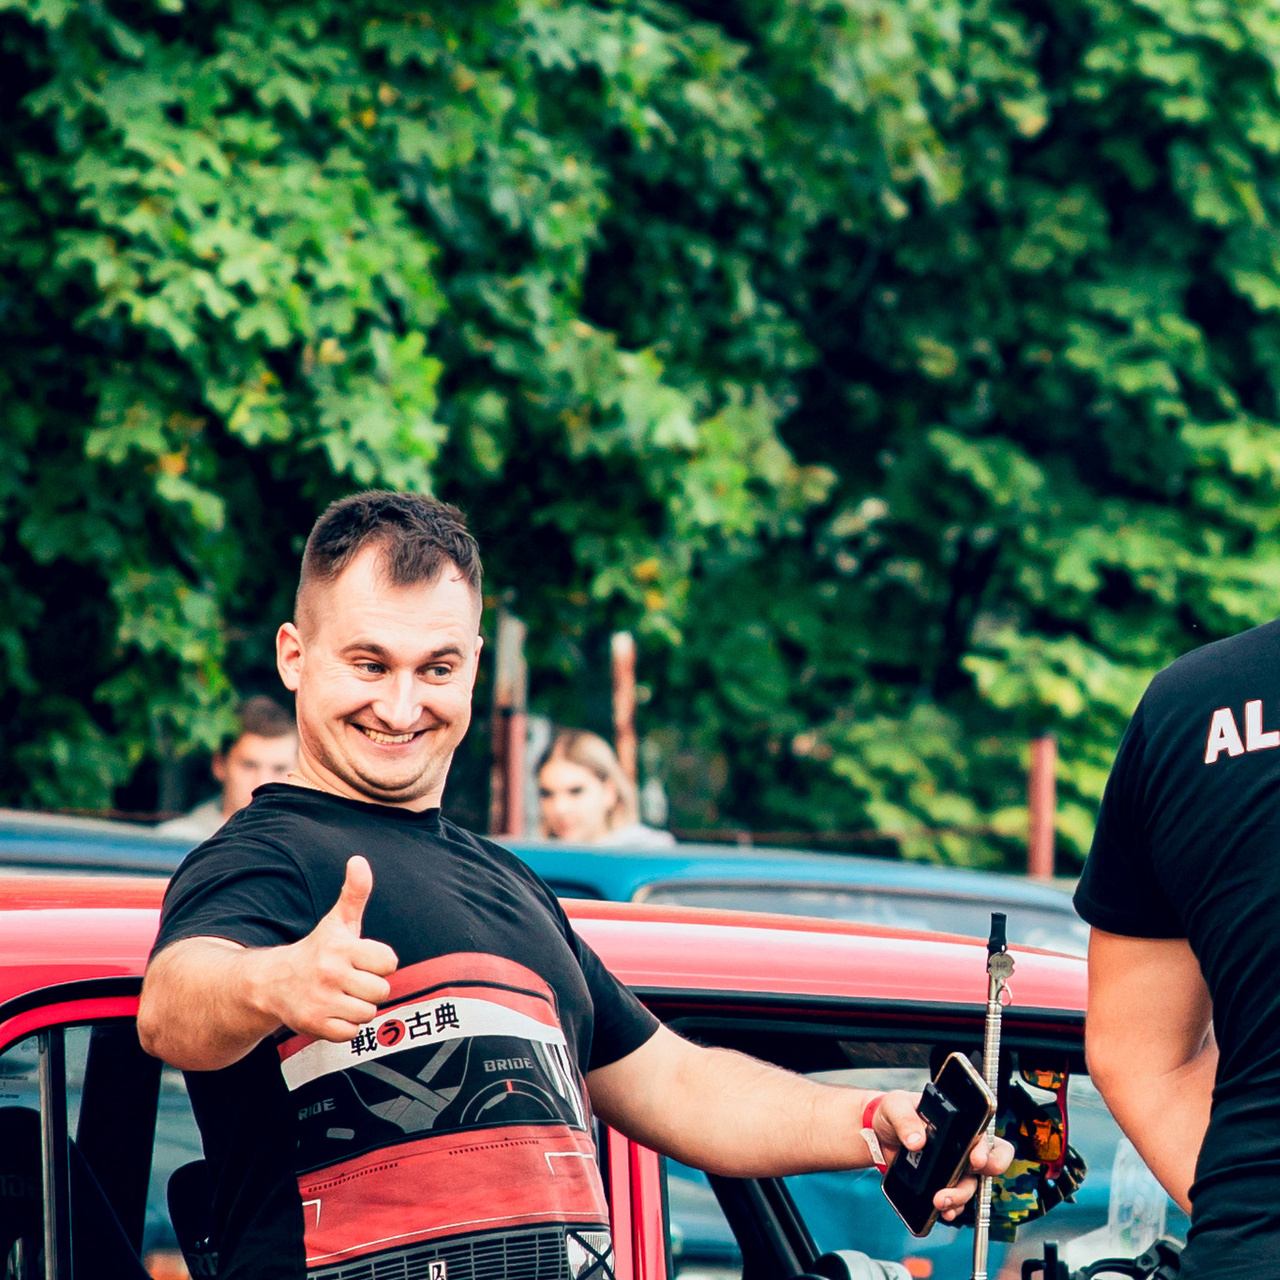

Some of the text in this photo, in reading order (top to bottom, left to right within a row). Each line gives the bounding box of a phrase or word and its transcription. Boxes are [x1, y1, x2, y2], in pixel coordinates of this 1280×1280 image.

[351, 1002, 460, 1057] 戦う古典
[483, 1057, 534, 1073] BRIDE
[297, 1097, 337, 1121] RIDE
